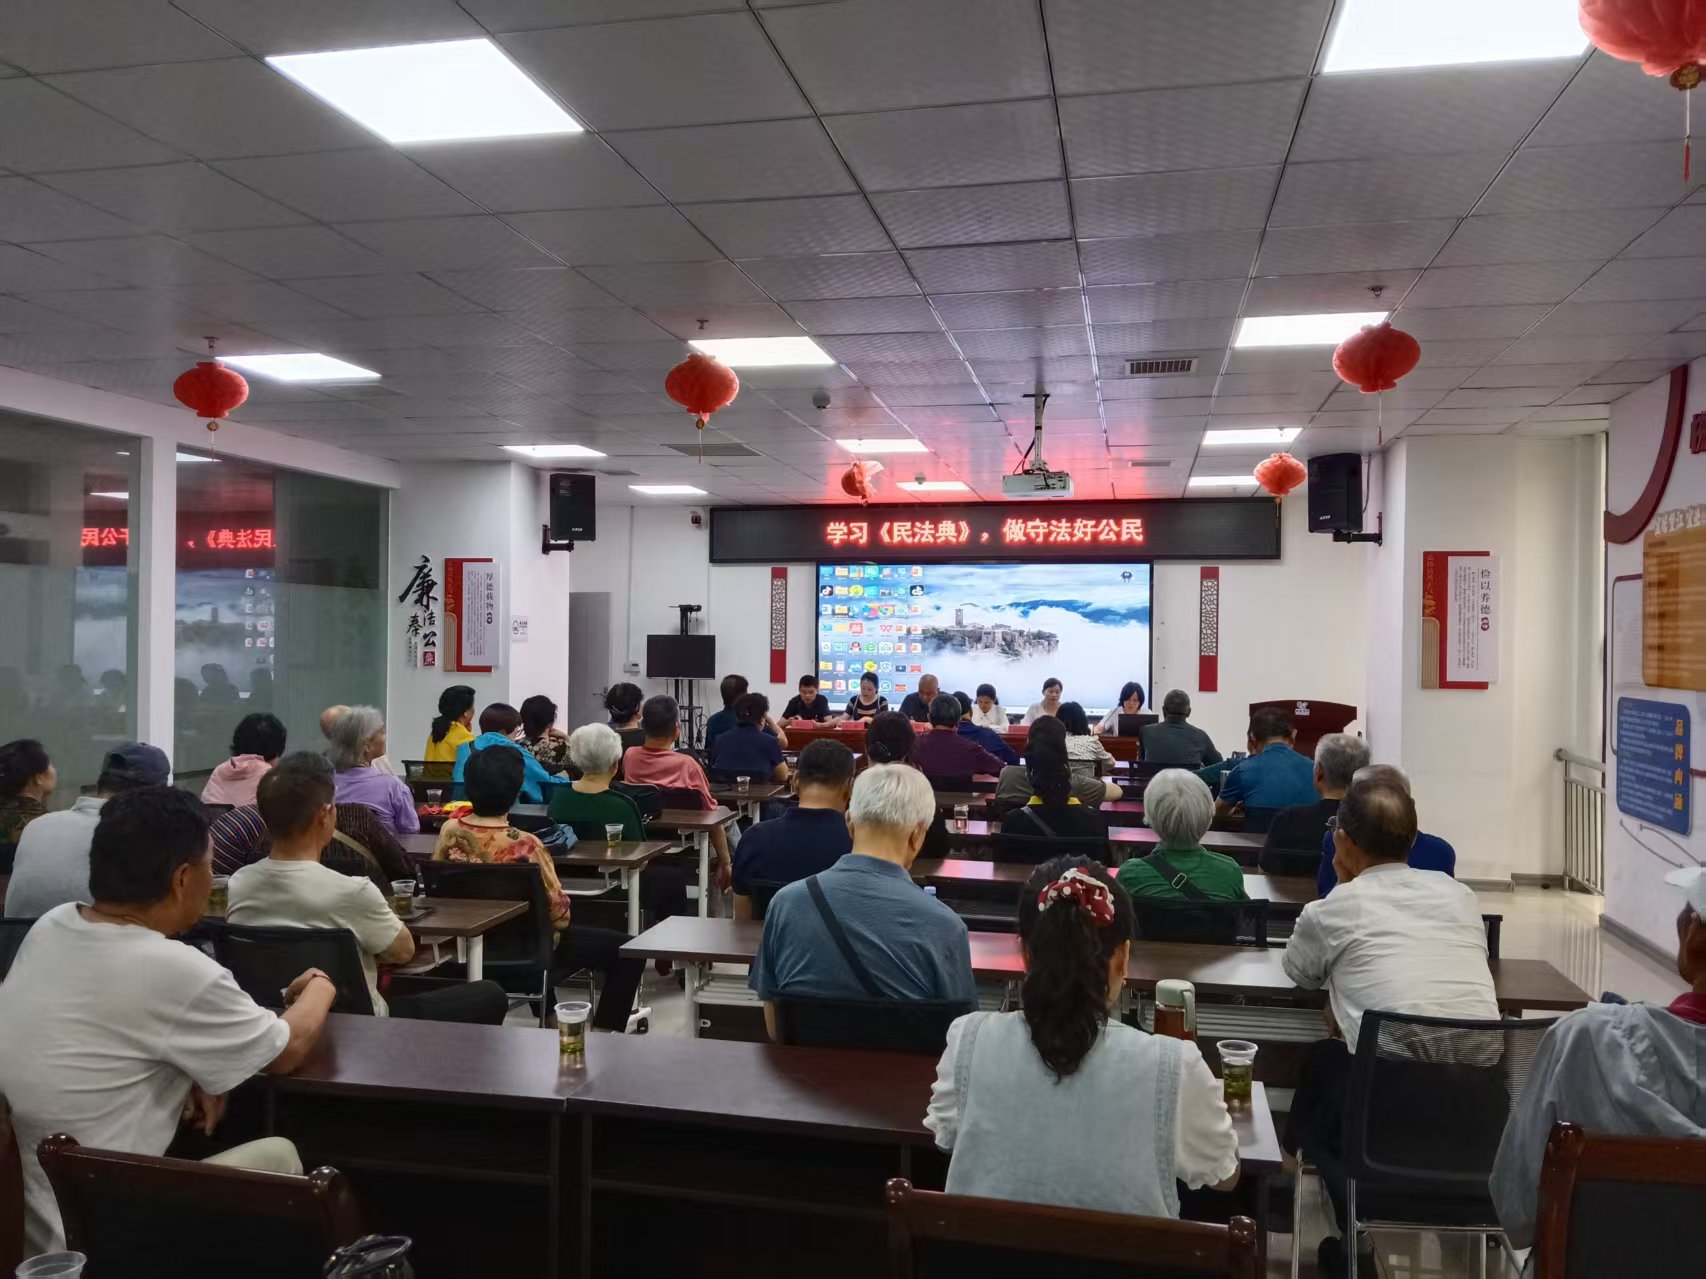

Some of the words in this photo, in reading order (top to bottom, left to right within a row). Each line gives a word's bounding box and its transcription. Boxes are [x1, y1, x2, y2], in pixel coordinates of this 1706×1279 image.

[826, 518, 1144, 544] 学习《民法典》，做守法好公民
